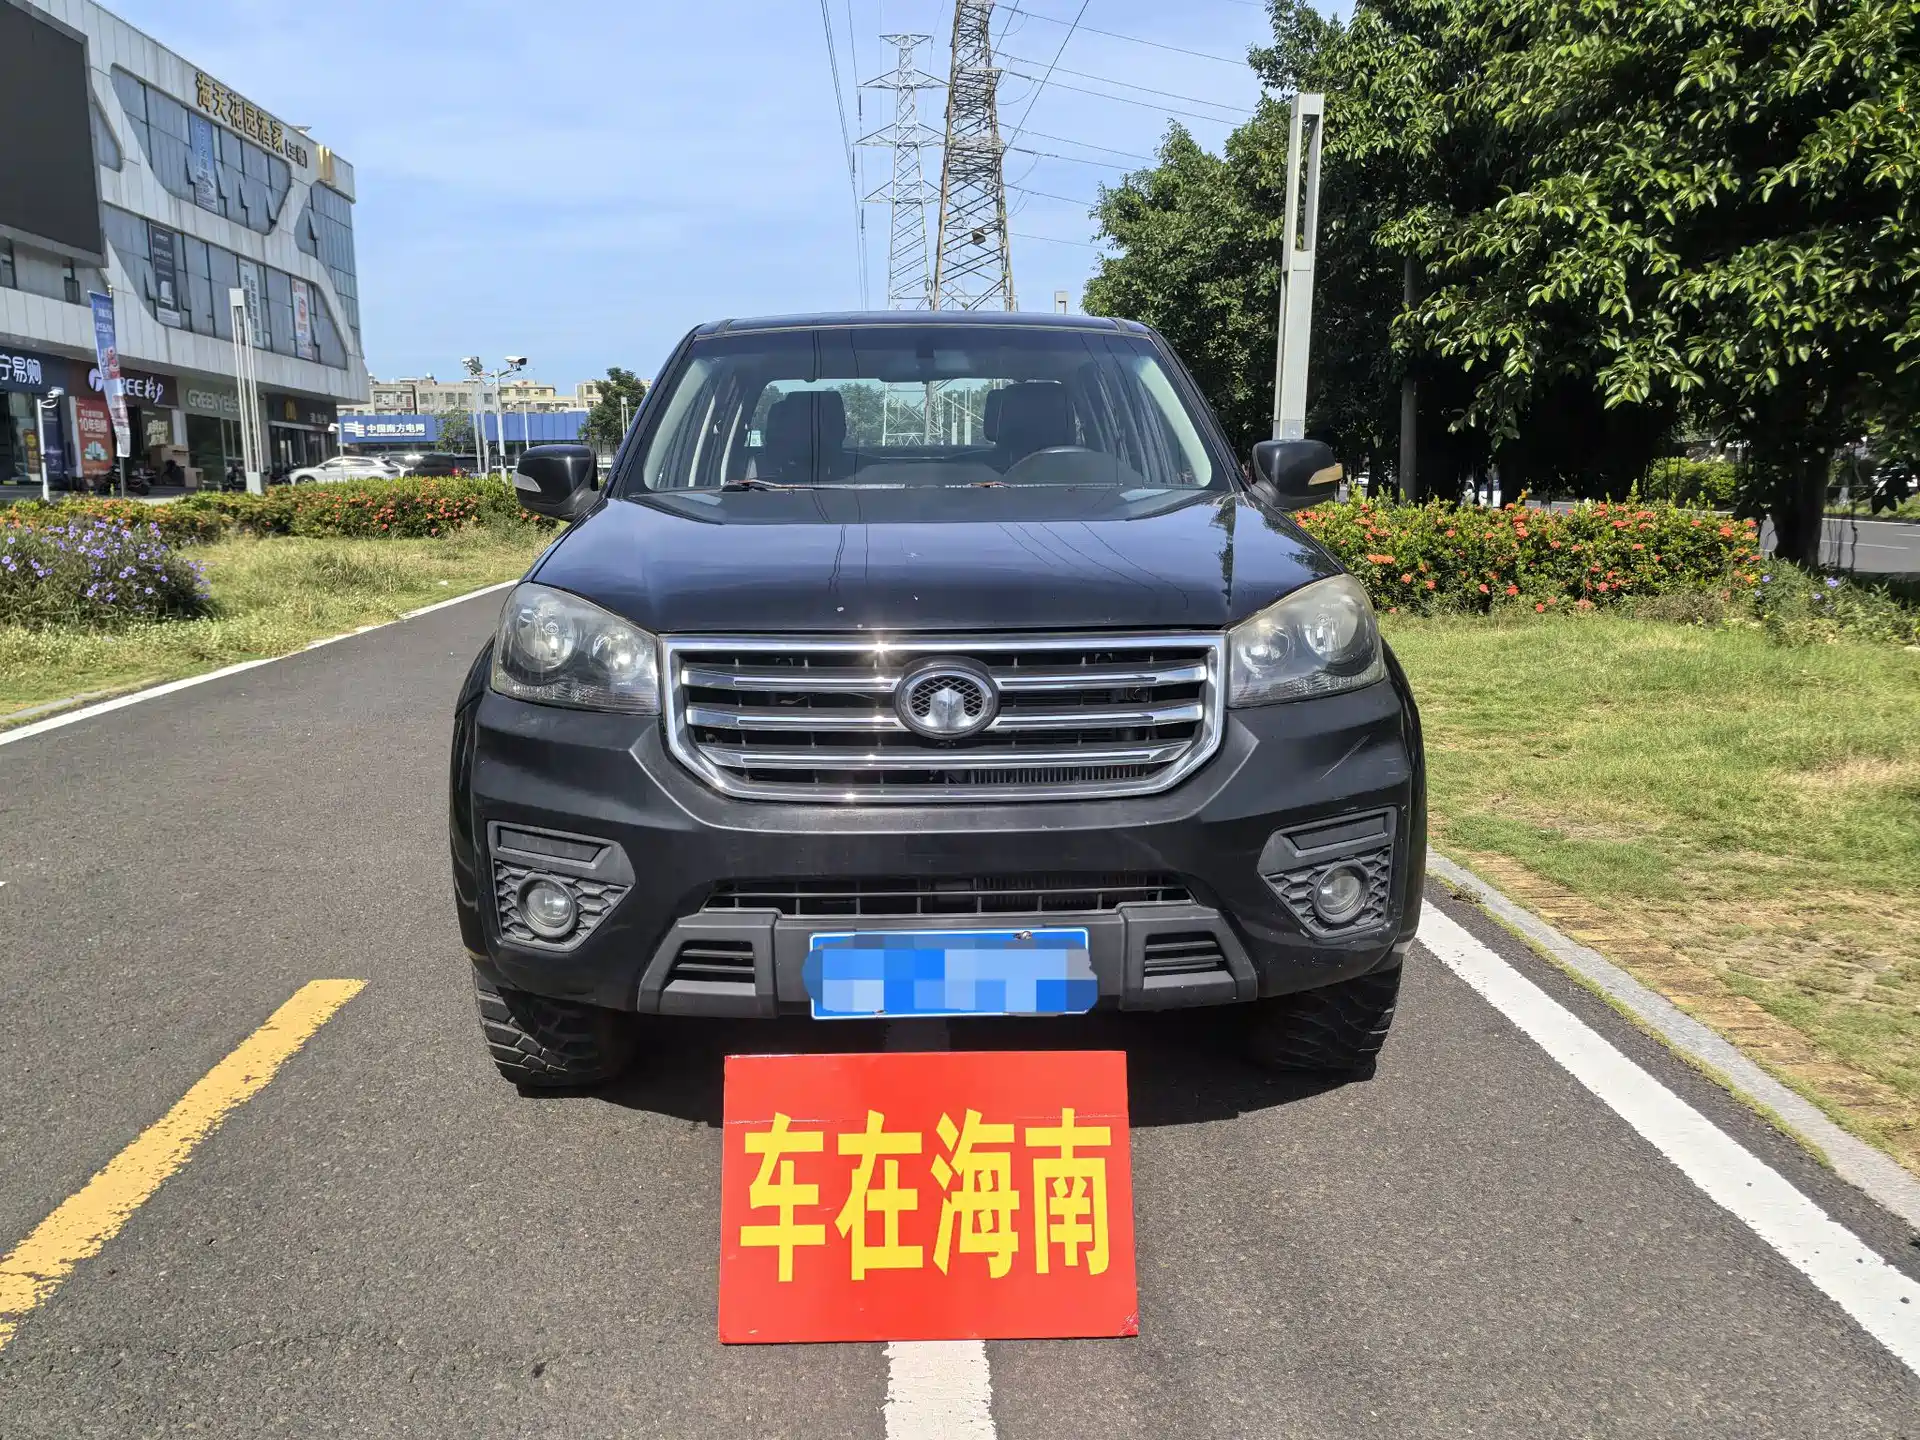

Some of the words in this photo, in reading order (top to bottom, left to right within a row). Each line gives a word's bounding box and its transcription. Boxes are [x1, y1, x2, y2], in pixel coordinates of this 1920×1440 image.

[0, 354, 42, 385] 宁易购
[366, 423, 425, 433] 中国南方电网
[740, 1107, 1111, 1283] 车在海南
